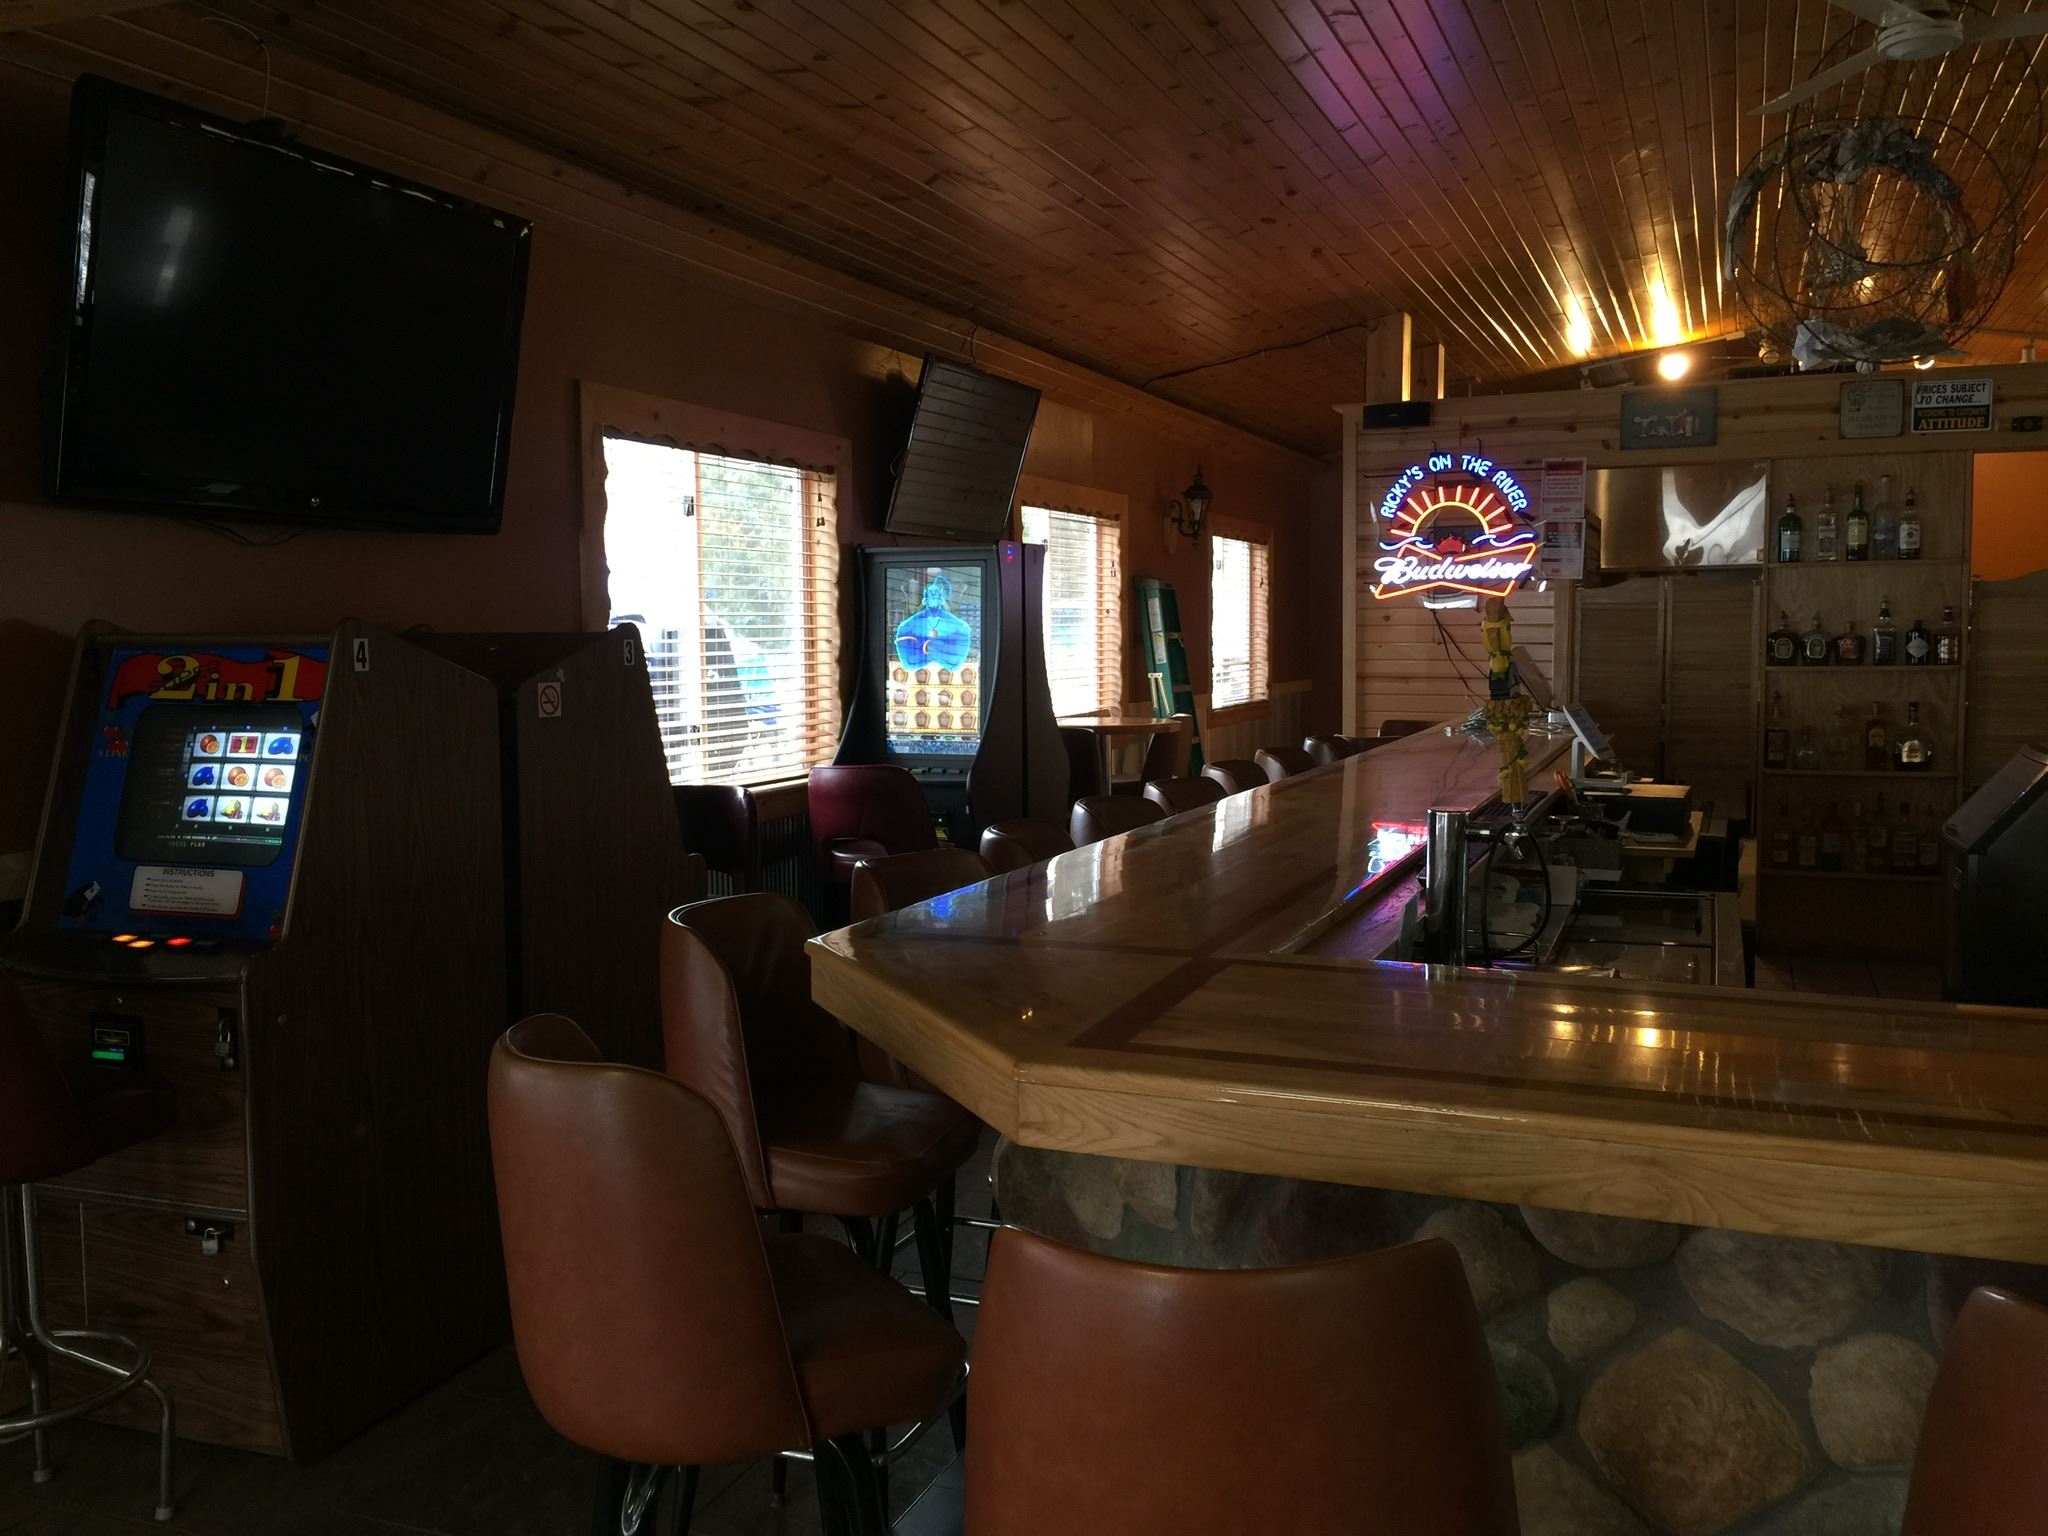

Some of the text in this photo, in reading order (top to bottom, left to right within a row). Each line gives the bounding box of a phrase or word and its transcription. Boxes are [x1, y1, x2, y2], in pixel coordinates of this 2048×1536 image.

[1916, 383, 1987, 394] PRICES SUBJECT
[1920, 395, 1932, 405] TO
[1919, 417, 1985, 430] ATTITUDE
[1380, 466, 1424, 518] RICKY'S
[1429, 454, 1452, 473] ON
[1461, 454, 1493, 477] THE
[1491, 469, 1529, 513] RIVER
[1373, 555, 1533, 586] Budweiser
[355, 640, 368, 668] 4
[625, 641, 634, 664] 3
[148, 654, 303, 702] 2 in 1
[162, 867, 215, 878] INSTRUCTIONS
